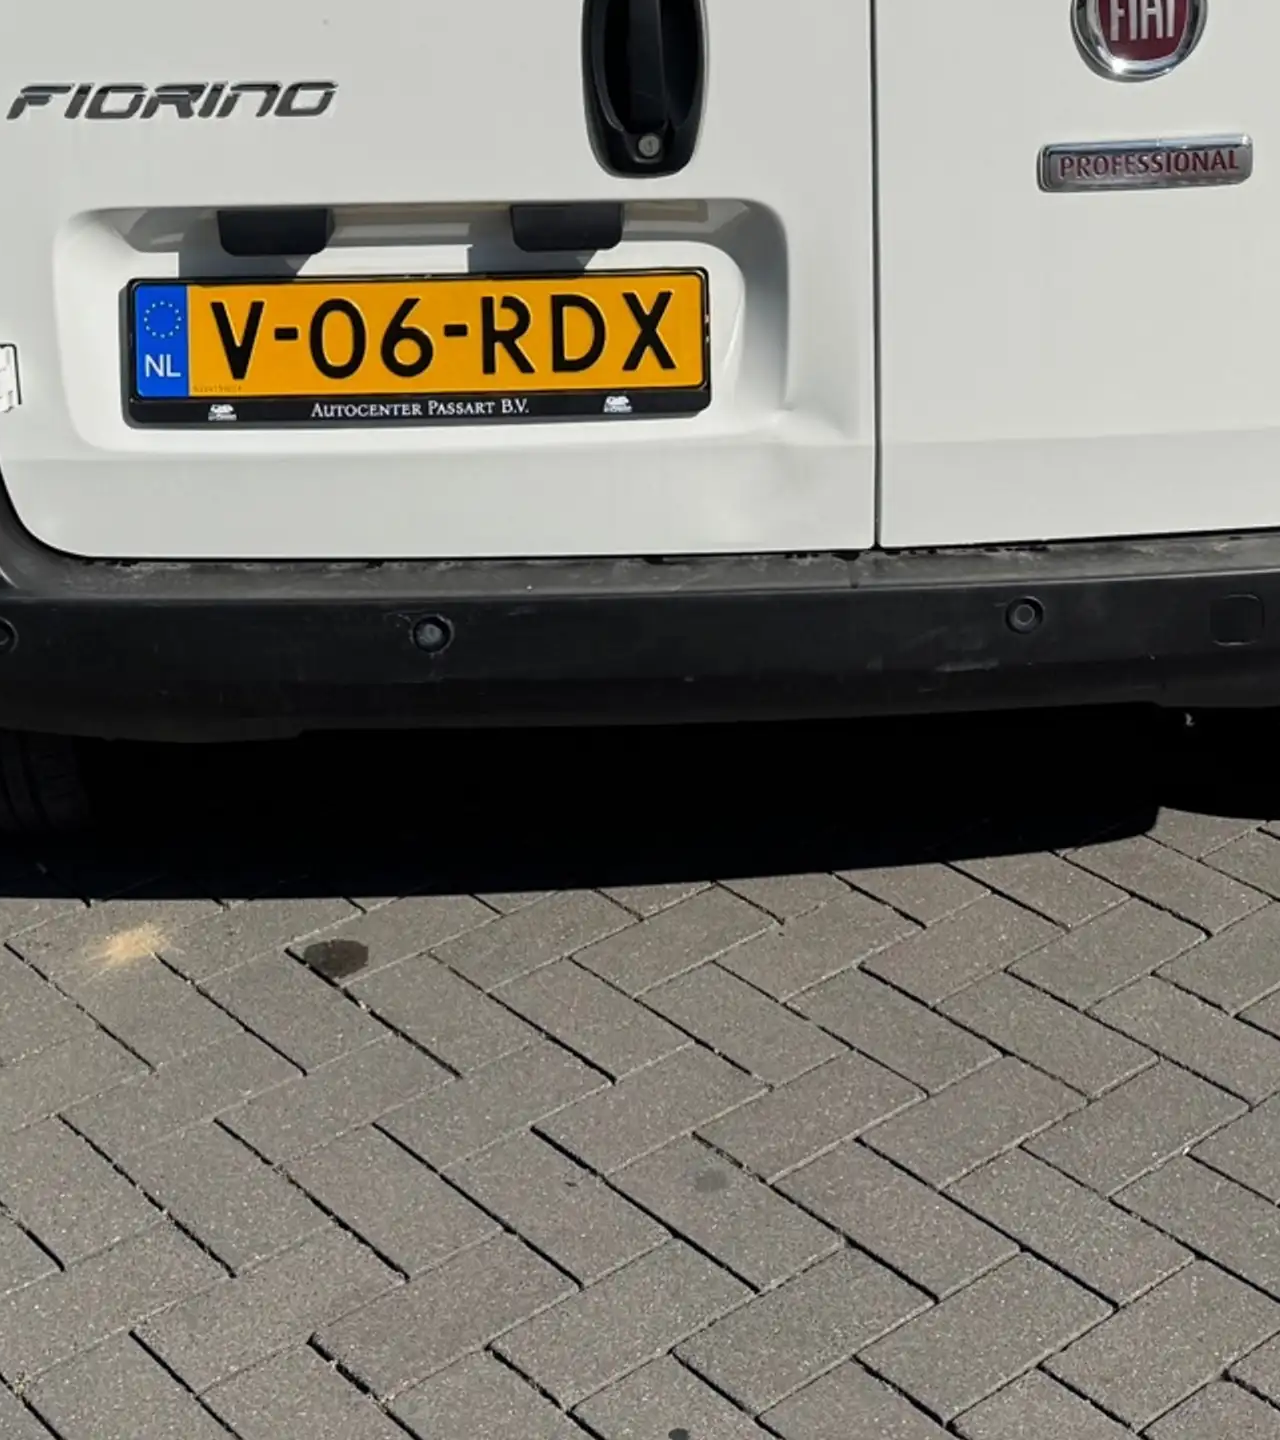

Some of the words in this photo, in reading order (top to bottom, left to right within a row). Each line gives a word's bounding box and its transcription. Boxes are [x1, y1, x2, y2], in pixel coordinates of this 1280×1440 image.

[6, 81, 338, 119] FIORINO
[1059, 149, 1239, 178] PROFESSIONAL
[210, 290, 678, 380] V-06-RDX
[144, 354, 182, 378] NL
[311, 402, 423, 418] AUTOCENTER
[428, 400, 496, 415] PASSART
[501, 398, 530, 414] B.V.
